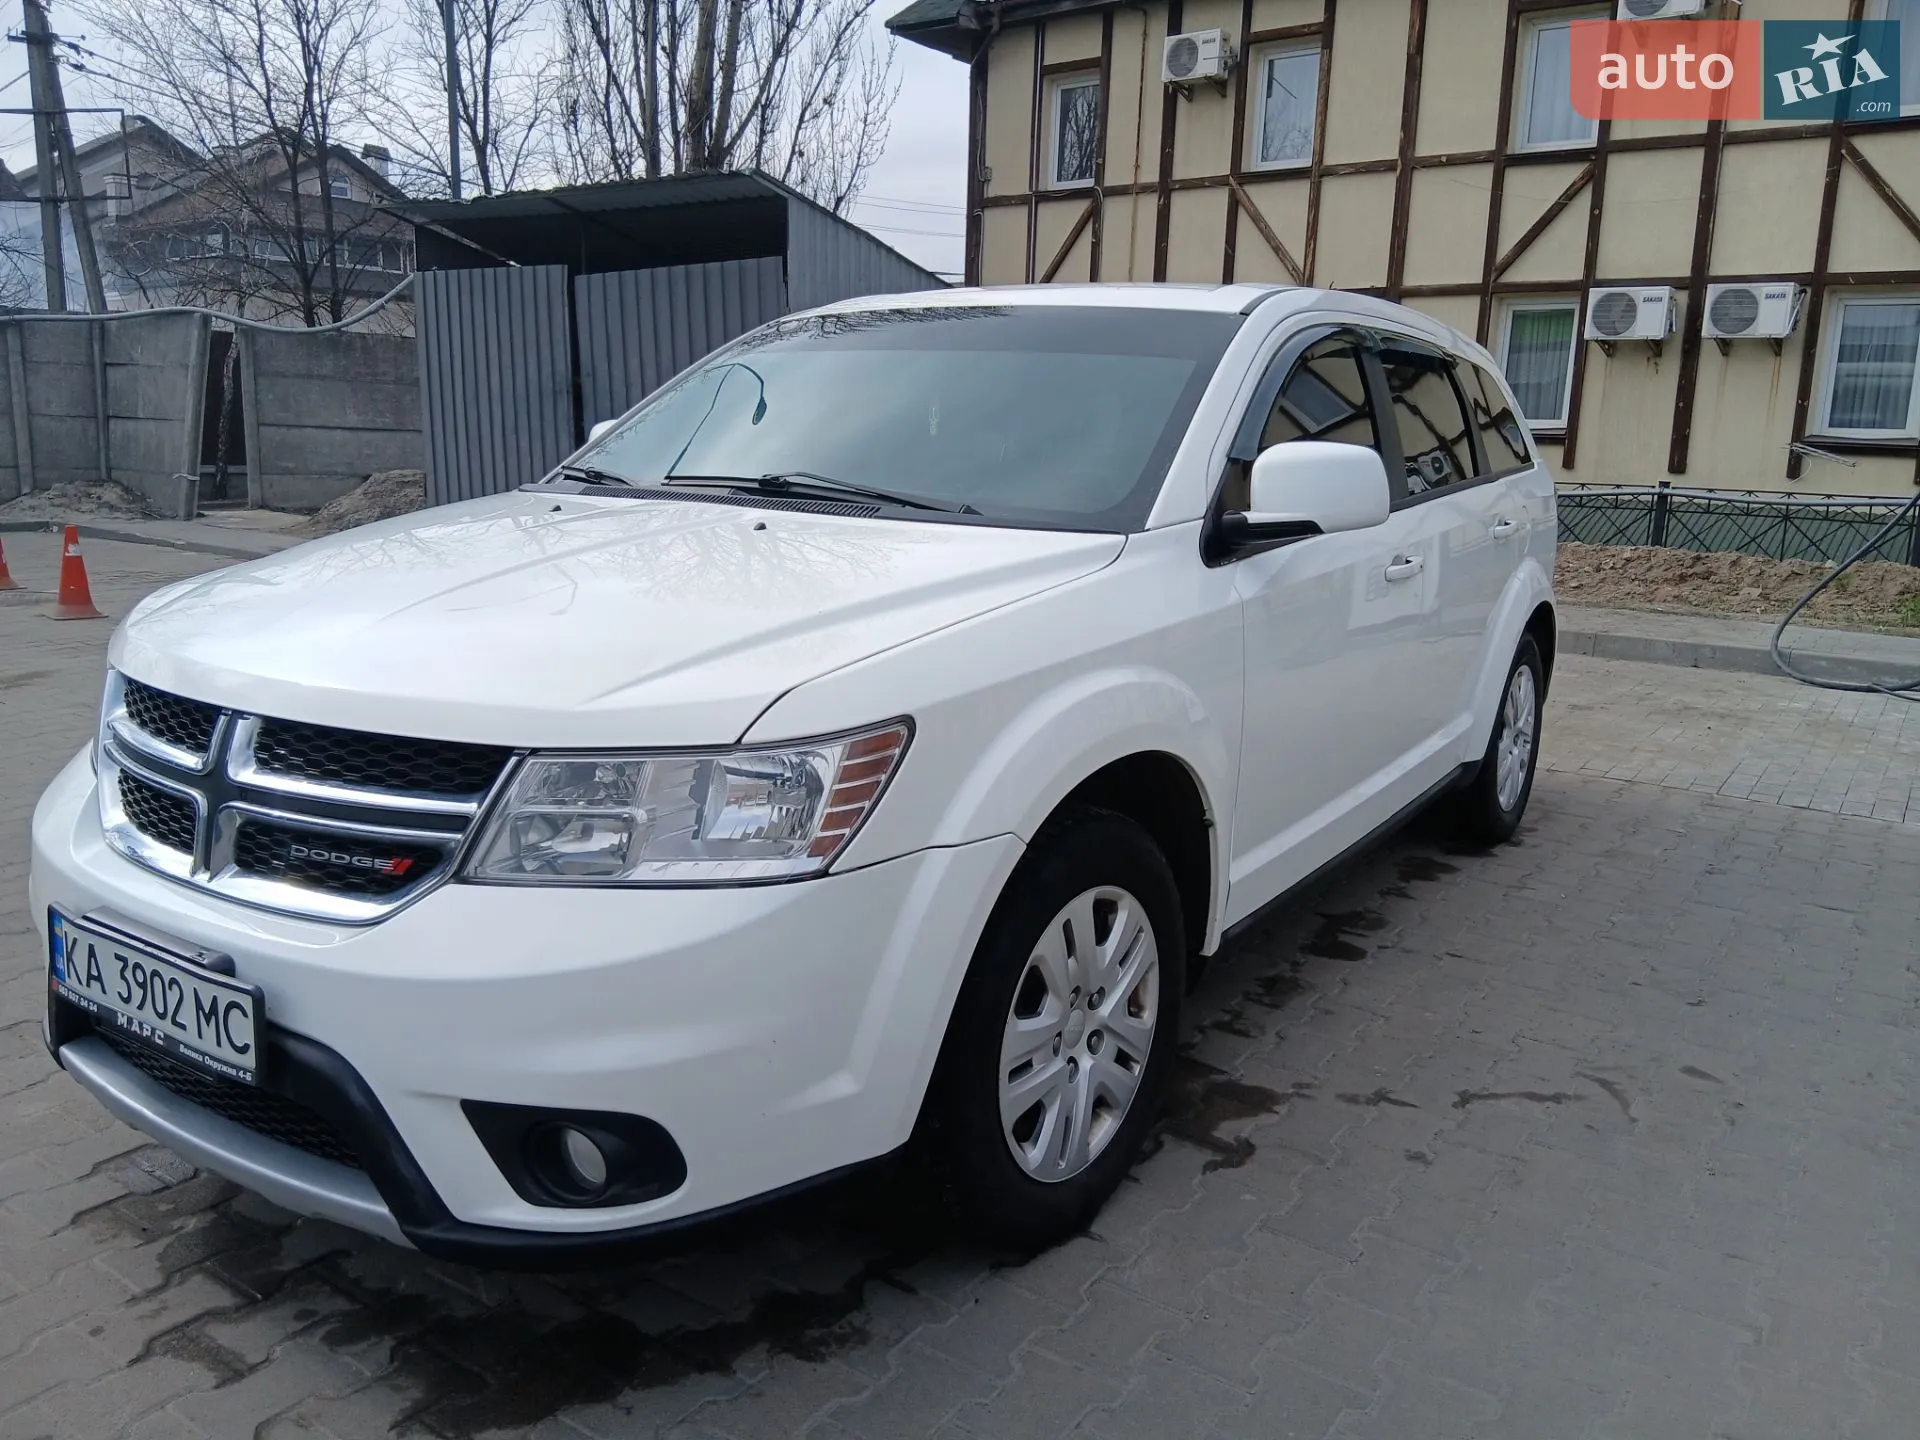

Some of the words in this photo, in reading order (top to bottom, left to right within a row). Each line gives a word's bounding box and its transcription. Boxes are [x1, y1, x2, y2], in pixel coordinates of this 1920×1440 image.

[290, 845, 394, 870] DODGE
[64, 930, 107, 995] KA
[114, 953, 187, 1032] 3902
[193, 987, 250, 1055] MC
